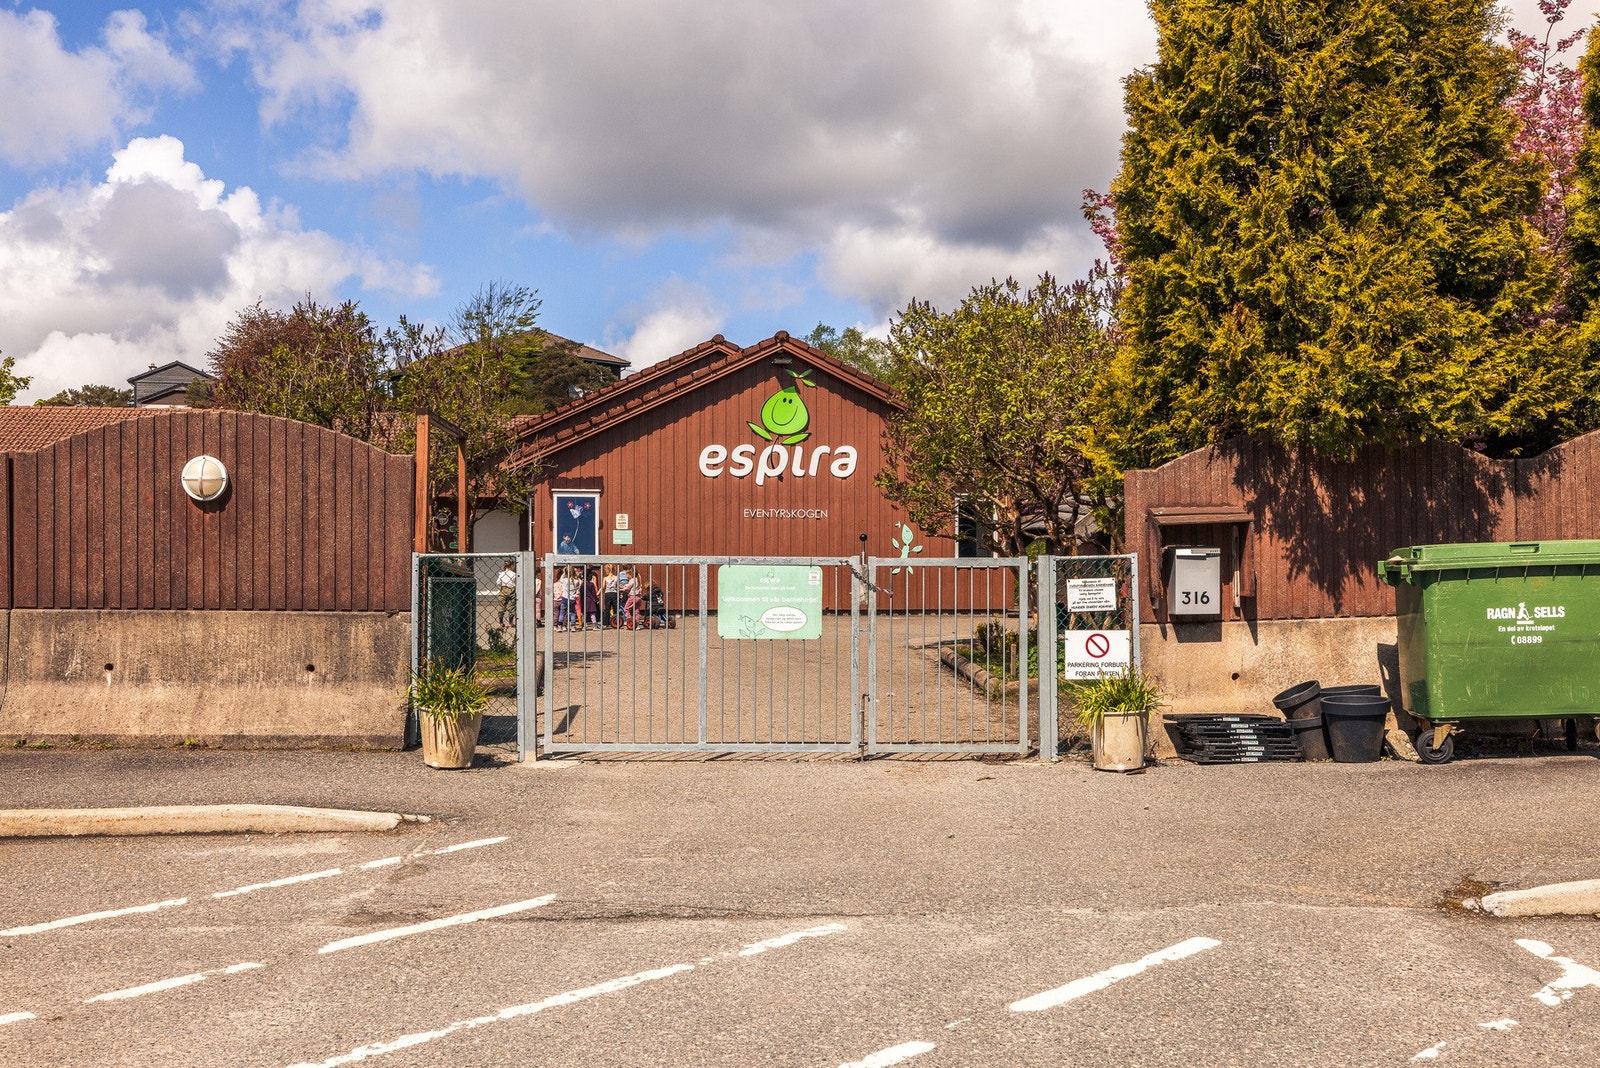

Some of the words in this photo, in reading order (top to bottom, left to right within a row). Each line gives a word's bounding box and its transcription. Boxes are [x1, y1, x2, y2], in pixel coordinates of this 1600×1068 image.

[698, 443, 858, 486] espira
[743, 508, 828, 519] EVENTYRSKOGEN
[1181, 591, 1210, 605] 316
[1486, 607, 1516, 620] RAGN
[1533, 606, 1566, 618] SELLS
[1516, 635, 1543, 644] 08899
